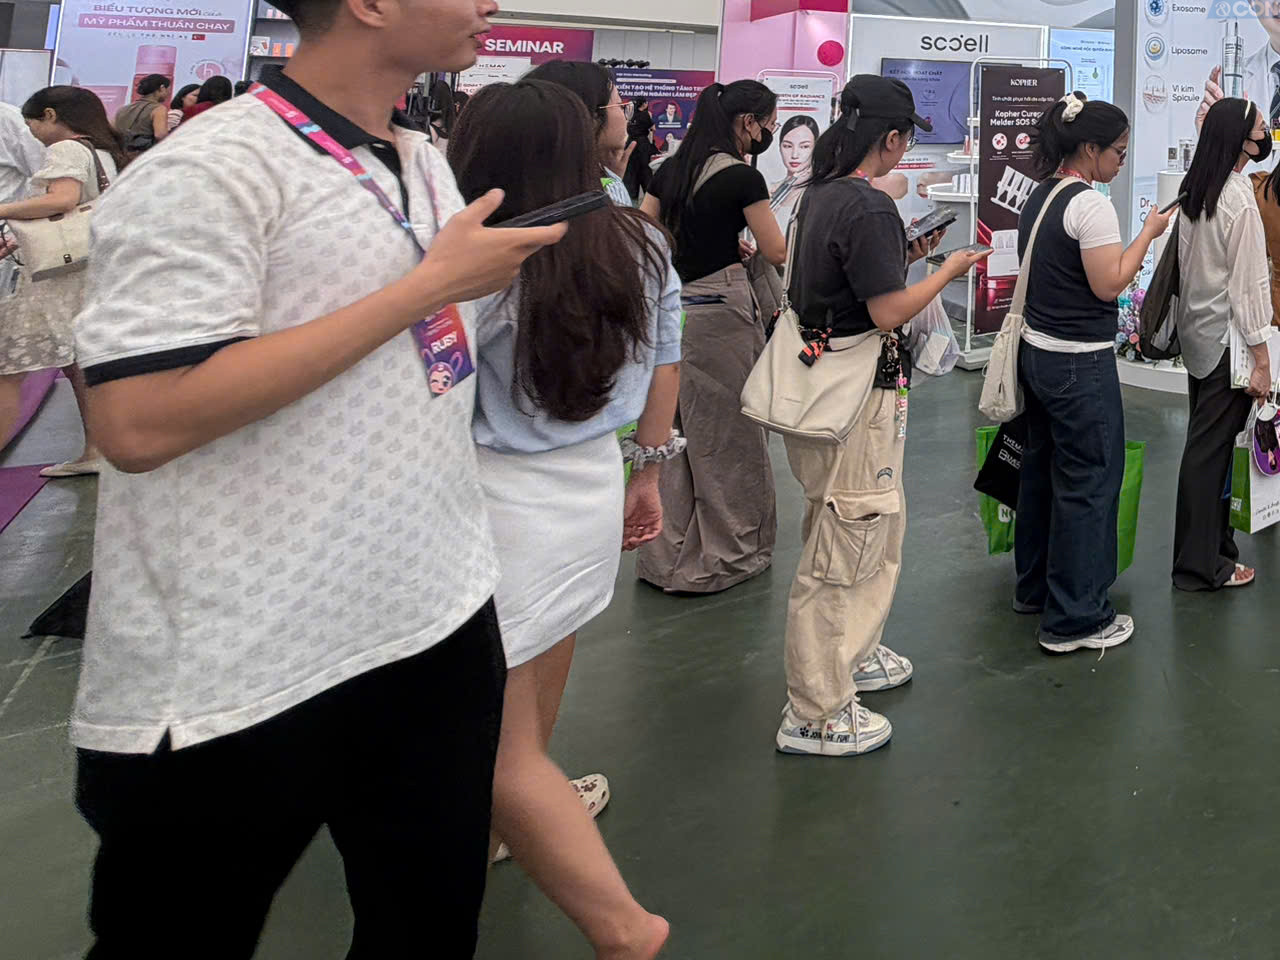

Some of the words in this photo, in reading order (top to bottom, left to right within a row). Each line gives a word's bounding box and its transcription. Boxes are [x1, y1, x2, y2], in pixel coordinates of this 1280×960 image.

[1172, 3, 1206, 13] Exosome
[196, 22, 230, 31] CHAY
[484, 38, 564, 54] SEMINAR
[1171, 46, 1208, 55] Liposome
[1010, 78, 1038, 87] KOPHER
[1172, 85, 1180, 93] Vi
[1181, 85, 1195, 93] kim
[1172, 94, 1200, 103] Spicule
[995, 110, 1020, 119] Kopher
